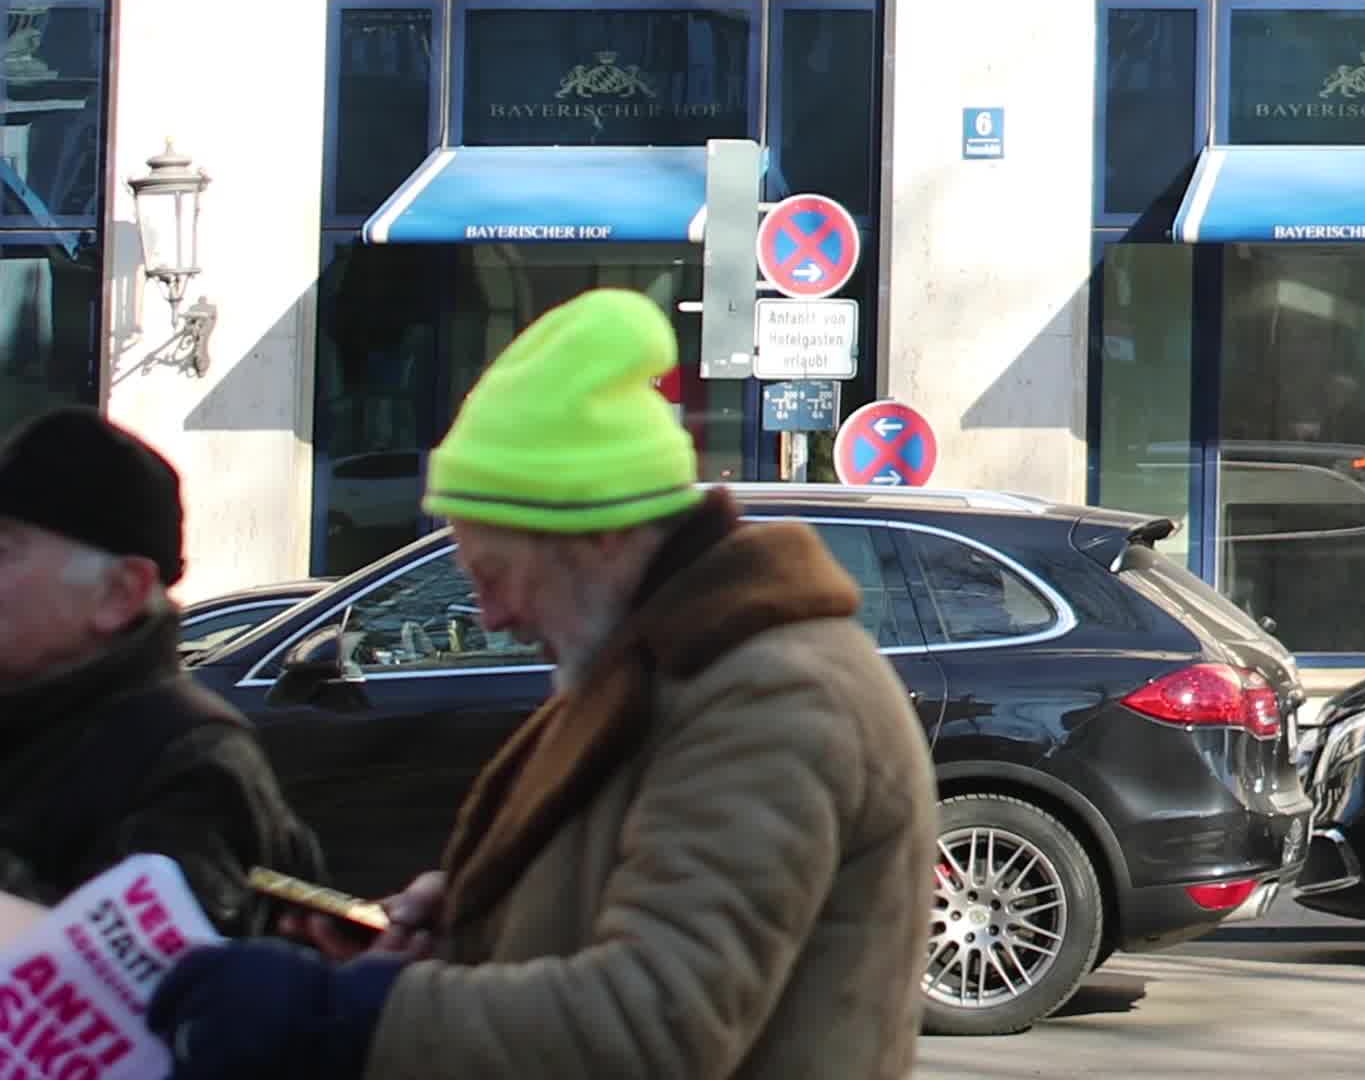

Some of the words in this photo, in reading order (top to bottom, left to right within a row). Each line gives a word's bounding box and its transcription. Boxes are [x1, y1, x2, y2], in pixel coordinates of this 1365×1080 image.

[976, 111, 992, 136] 6
[465, 224, 575, 239] BAYERISCHER
[578, 224, 611, 238] HOF
[10, 951, 135, 1067] ANTI
